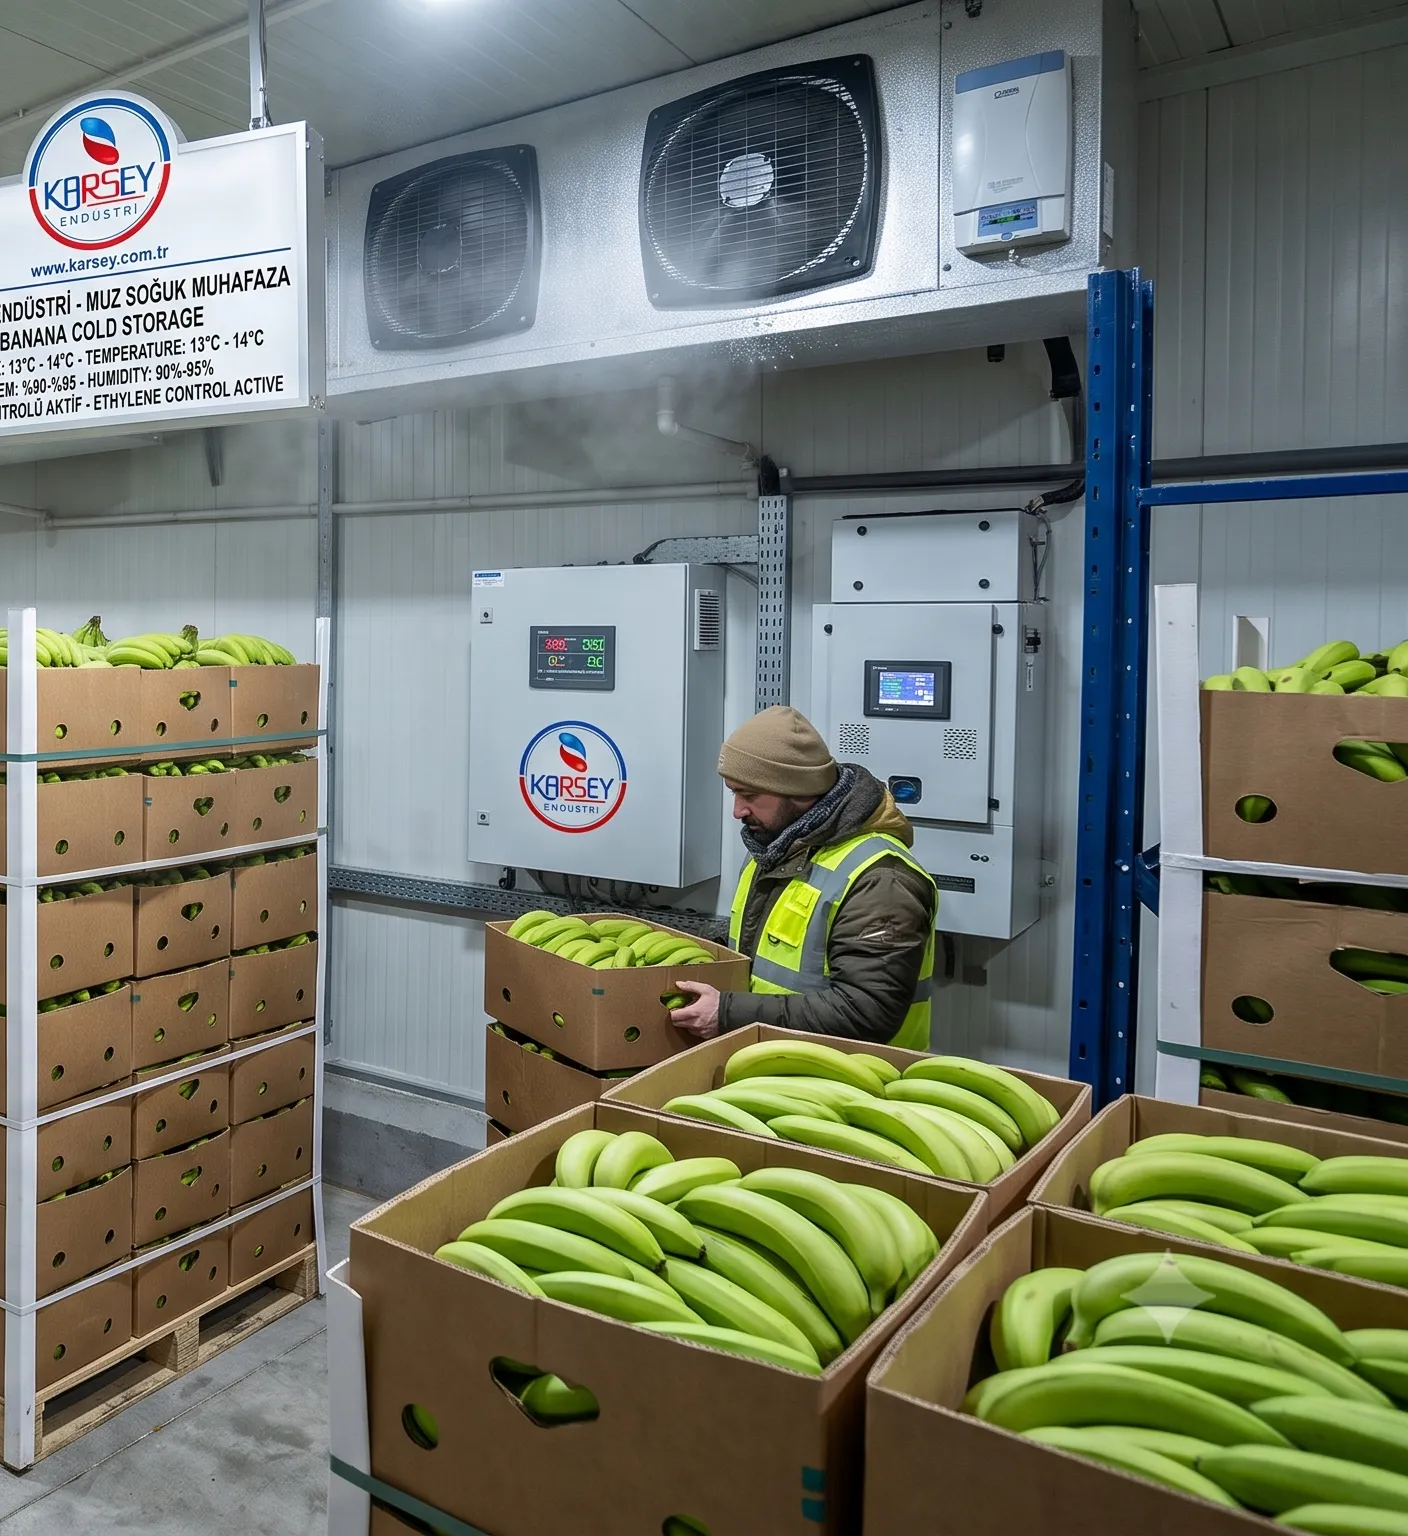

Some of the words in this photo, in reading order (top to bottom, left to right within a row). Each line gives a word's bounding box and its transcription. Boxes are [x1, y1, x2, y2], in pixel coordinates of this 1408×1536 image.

[44, 161, 156, 212] KARSEY
[30, 245, 169, 277] www.karsey.com.tr
[86, 287, 121, 313] MUZ
[125, 277, 187, 307] SOĞUK
[192, 265, 291, 299] MUHAFAZA
[0, 324, 67, 352] BANANA
[72, 317, 117, 342] COLD
[122, 306, 204, 336] STORAGE
[8, 356, 36, 375] 13°C
[46, 352, 74, 371] 14°C
[85, 338, 186, 366] TEMPERATURE:
[190, 334, 220, 354] 13°C
[232, 329, 264, 349] 14°C
[22, 374, 76, 396] %90-%95
[87, 366, 152, 389] HUMIDITY:
[155, 358, 214, 381] 90%-95%
[45, 393, 83, 416] AKTİF
[94, 388, 161, 411] ETHYLENE
[165, 380, 231, 403] CONTROL
[234, 375, 284, 397] ACTIVE
[530, 773, 614, 801] KARSEY
